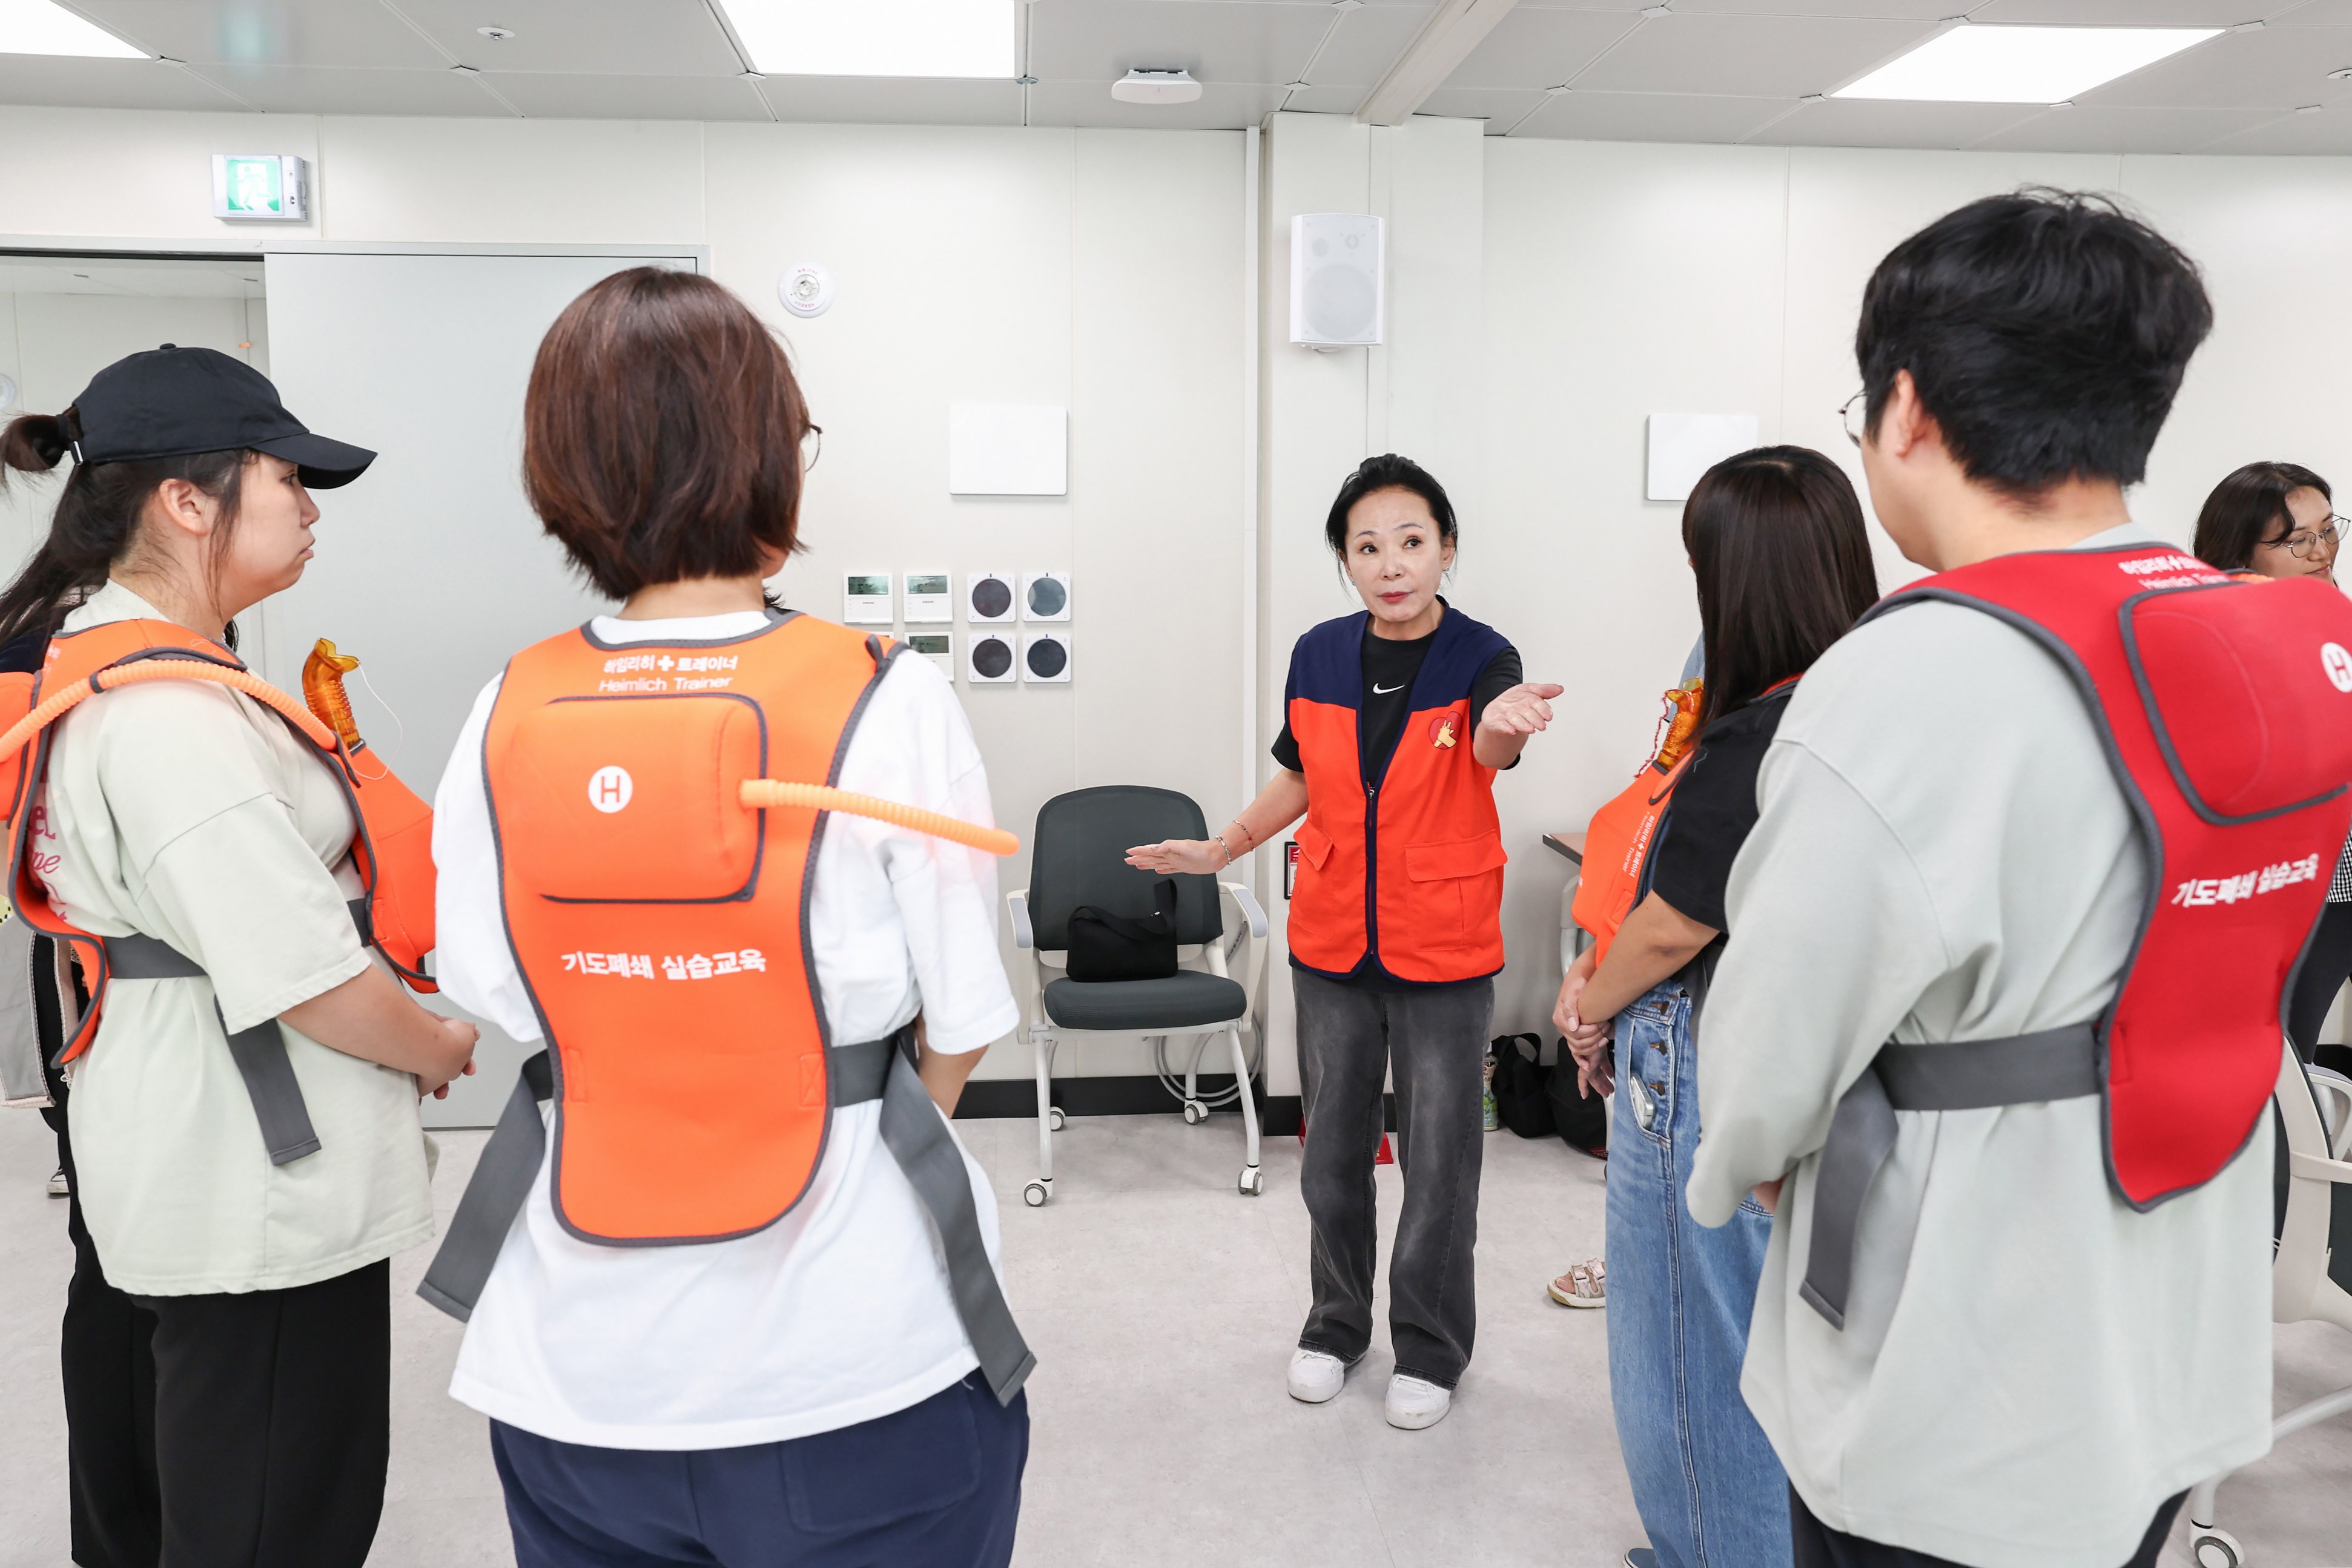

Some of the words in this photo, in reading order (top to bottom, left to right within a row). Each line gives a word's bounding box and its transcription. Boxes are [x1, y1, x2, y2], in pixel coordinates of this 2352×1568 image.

[603, 654, 656, 673] 하임리히
[675, 655, 738, 672] 트레이너
[598, 677, 667, 692] Heimlich
[673, 677, 733, 691] Trainer
[600, 776, 621, 803] H
[2171, 870, 2258, 908] 기도폐쇄
[2256, 852, 2319, 894] 실습교육
[561, 951, 655, 980] 기도폐쇄
[661, 949, 767, 980] 실습교육
